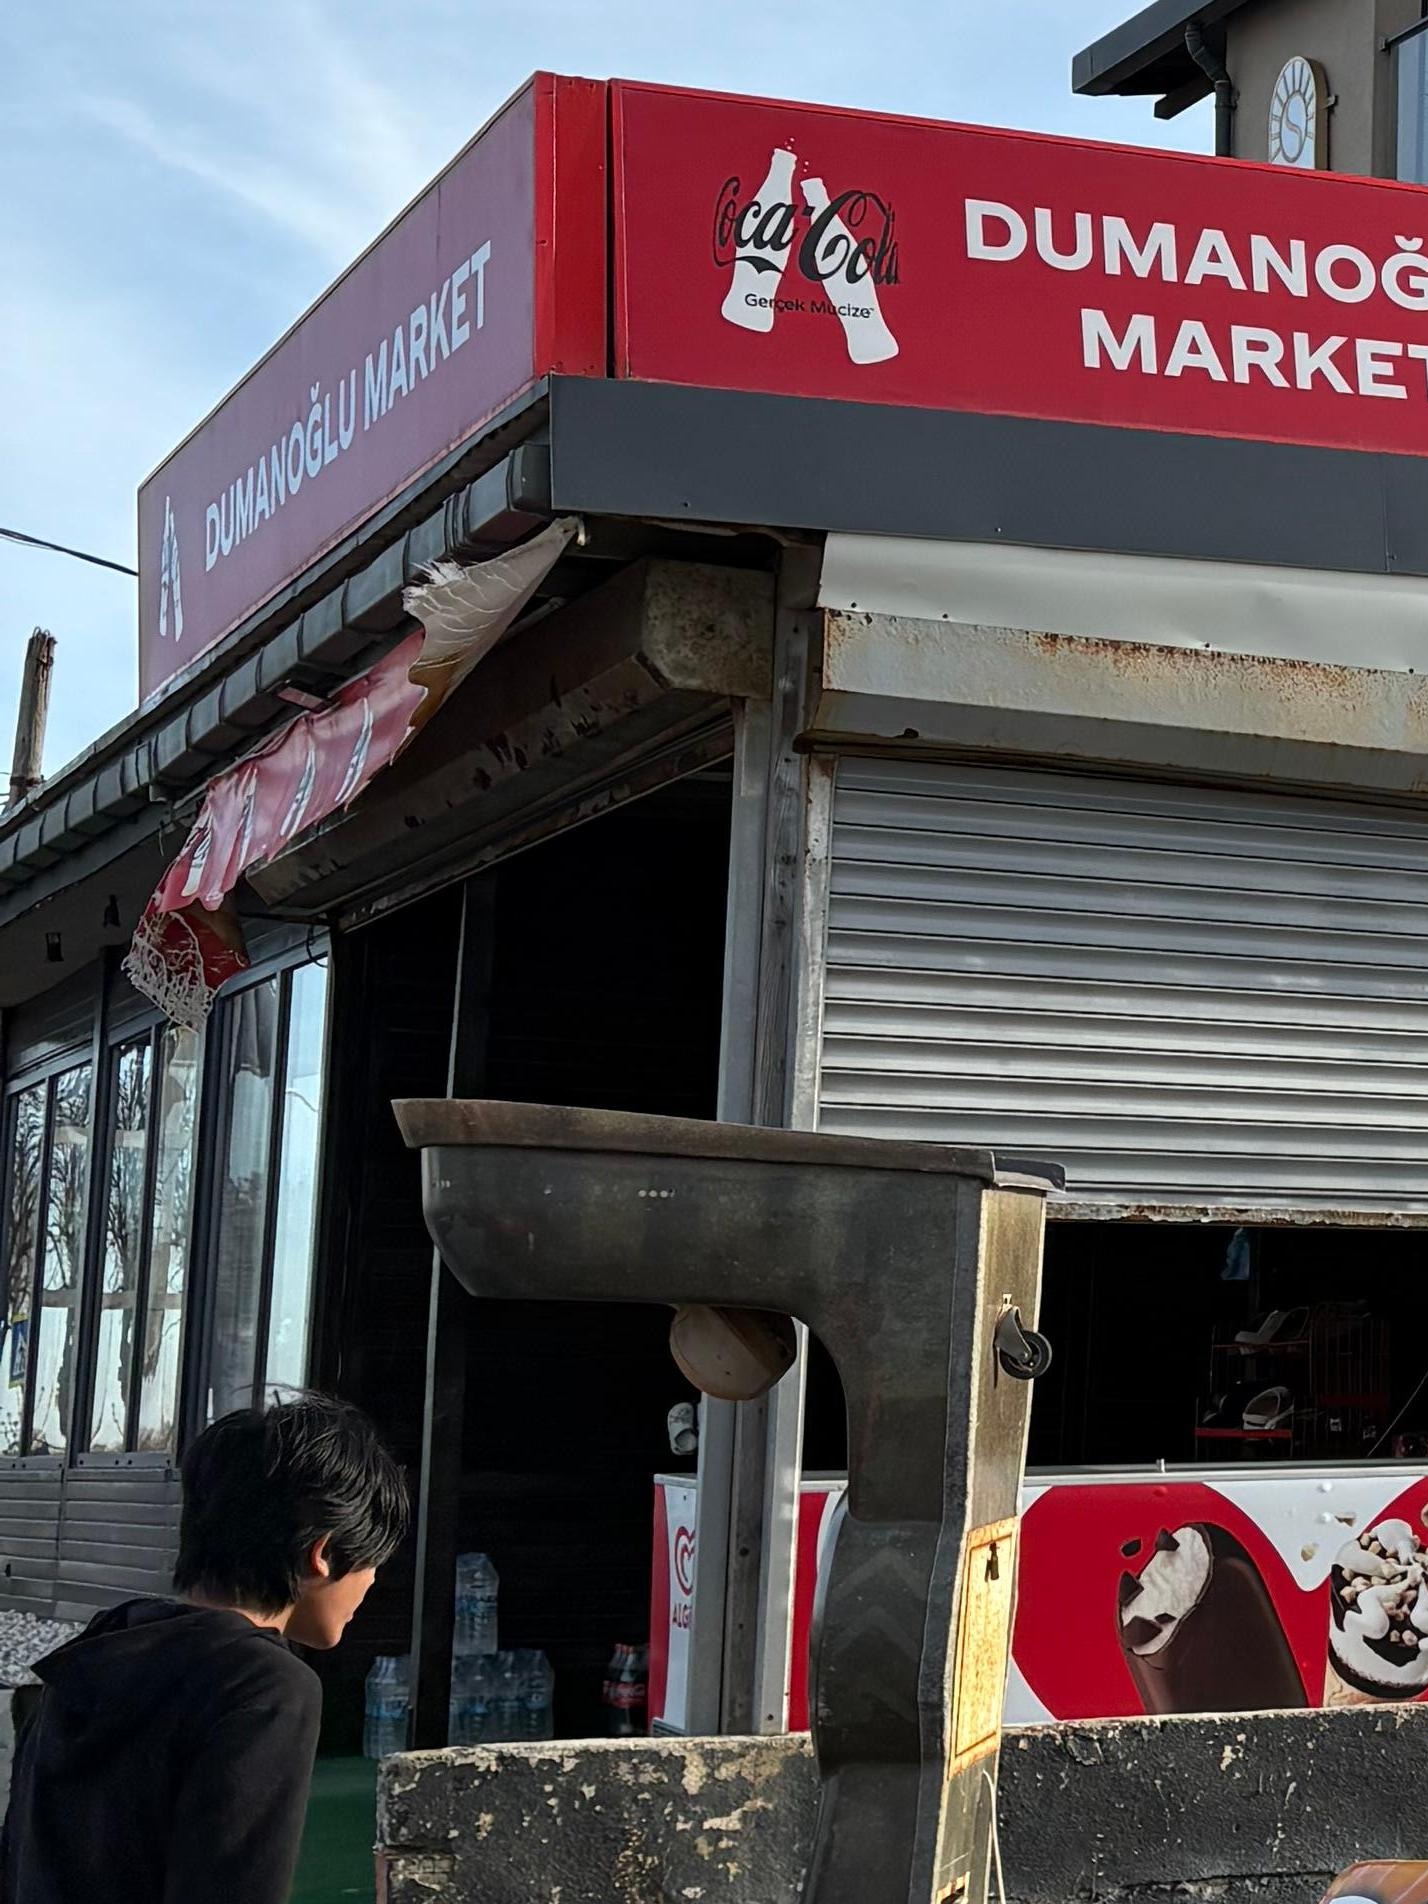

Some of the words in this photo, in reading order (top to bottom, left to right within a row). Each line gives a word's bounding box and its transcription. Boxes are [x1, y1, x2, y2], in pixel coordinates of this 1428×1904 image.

[744, 293, 804, 313] Gerçek
[205, 382, 357, 573] DUMANOĞLU
[363, 239, 492, 432] MARKET
